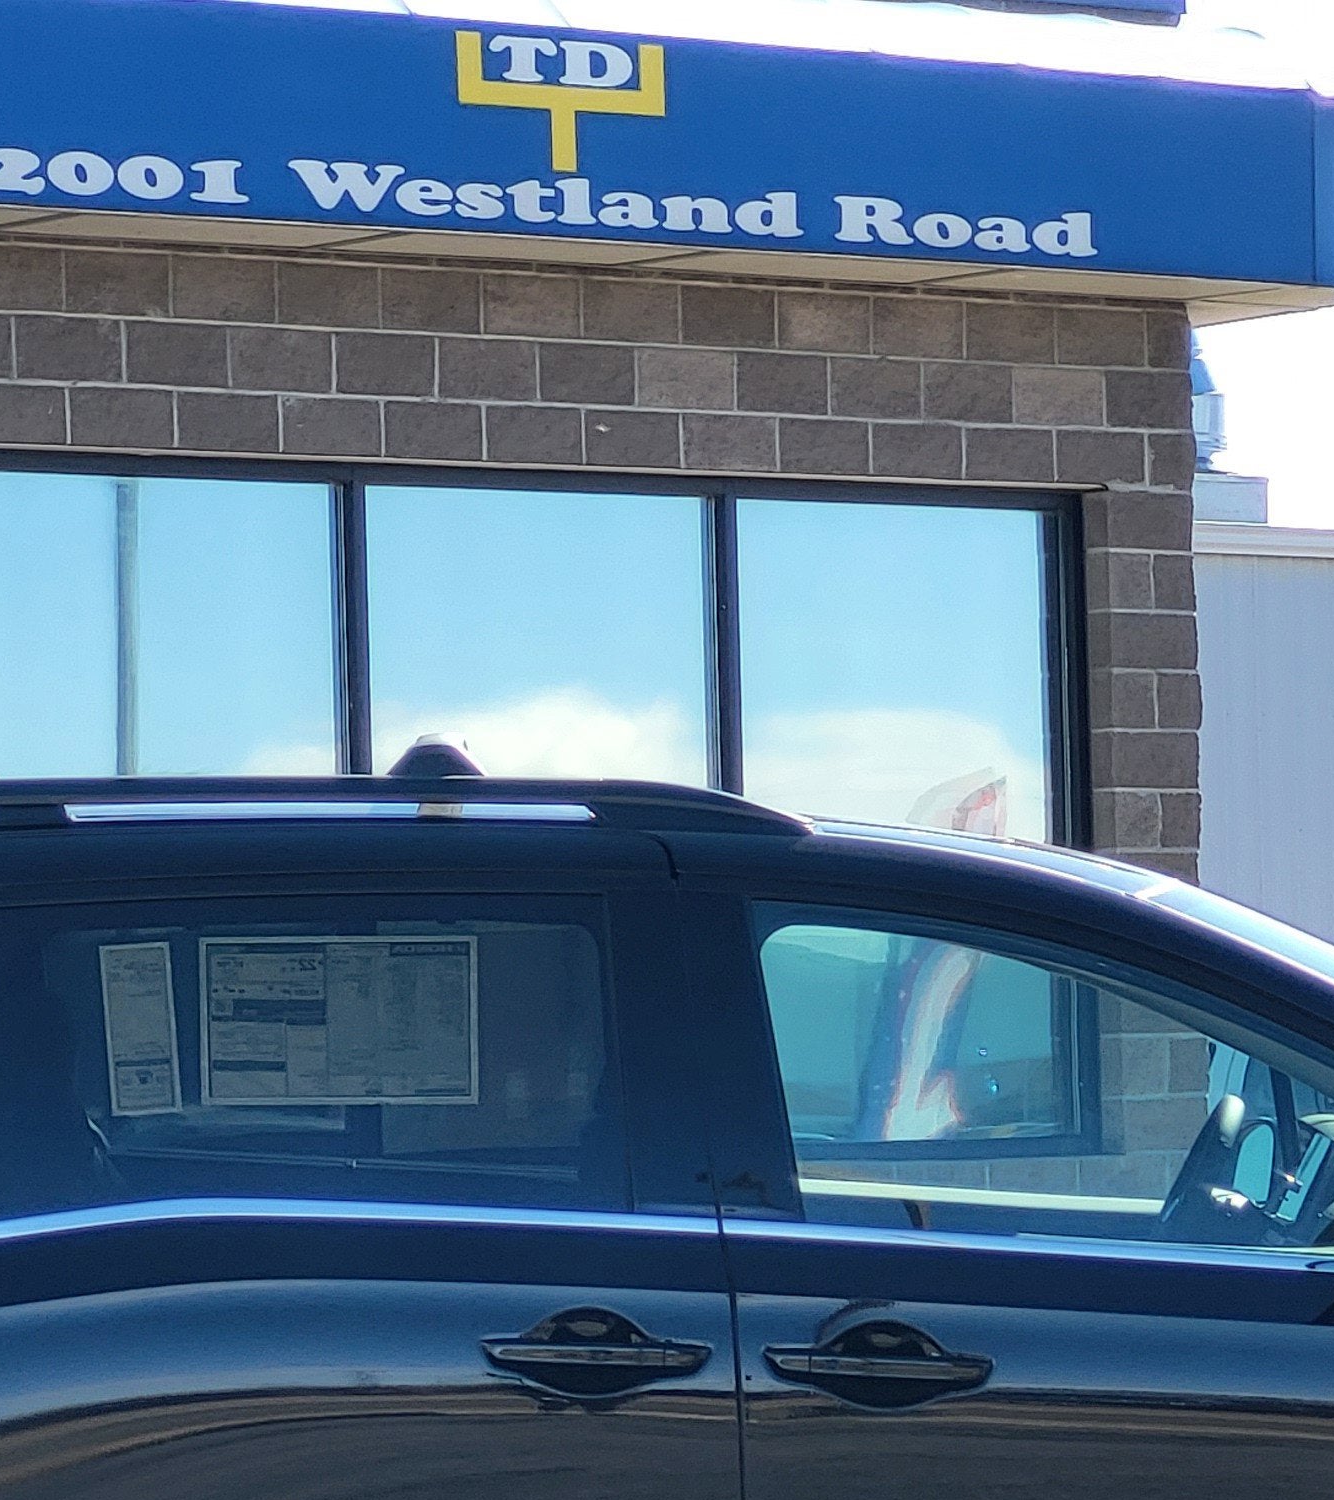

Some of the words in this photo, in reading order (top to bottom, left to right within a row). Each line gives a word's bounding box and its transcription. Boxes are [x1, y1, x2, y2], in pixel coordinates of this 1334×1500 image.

[488, 35, 633, 87] TD
[288, 159, 803, 239] Westland
[835, 195, 1098, 257] Road
